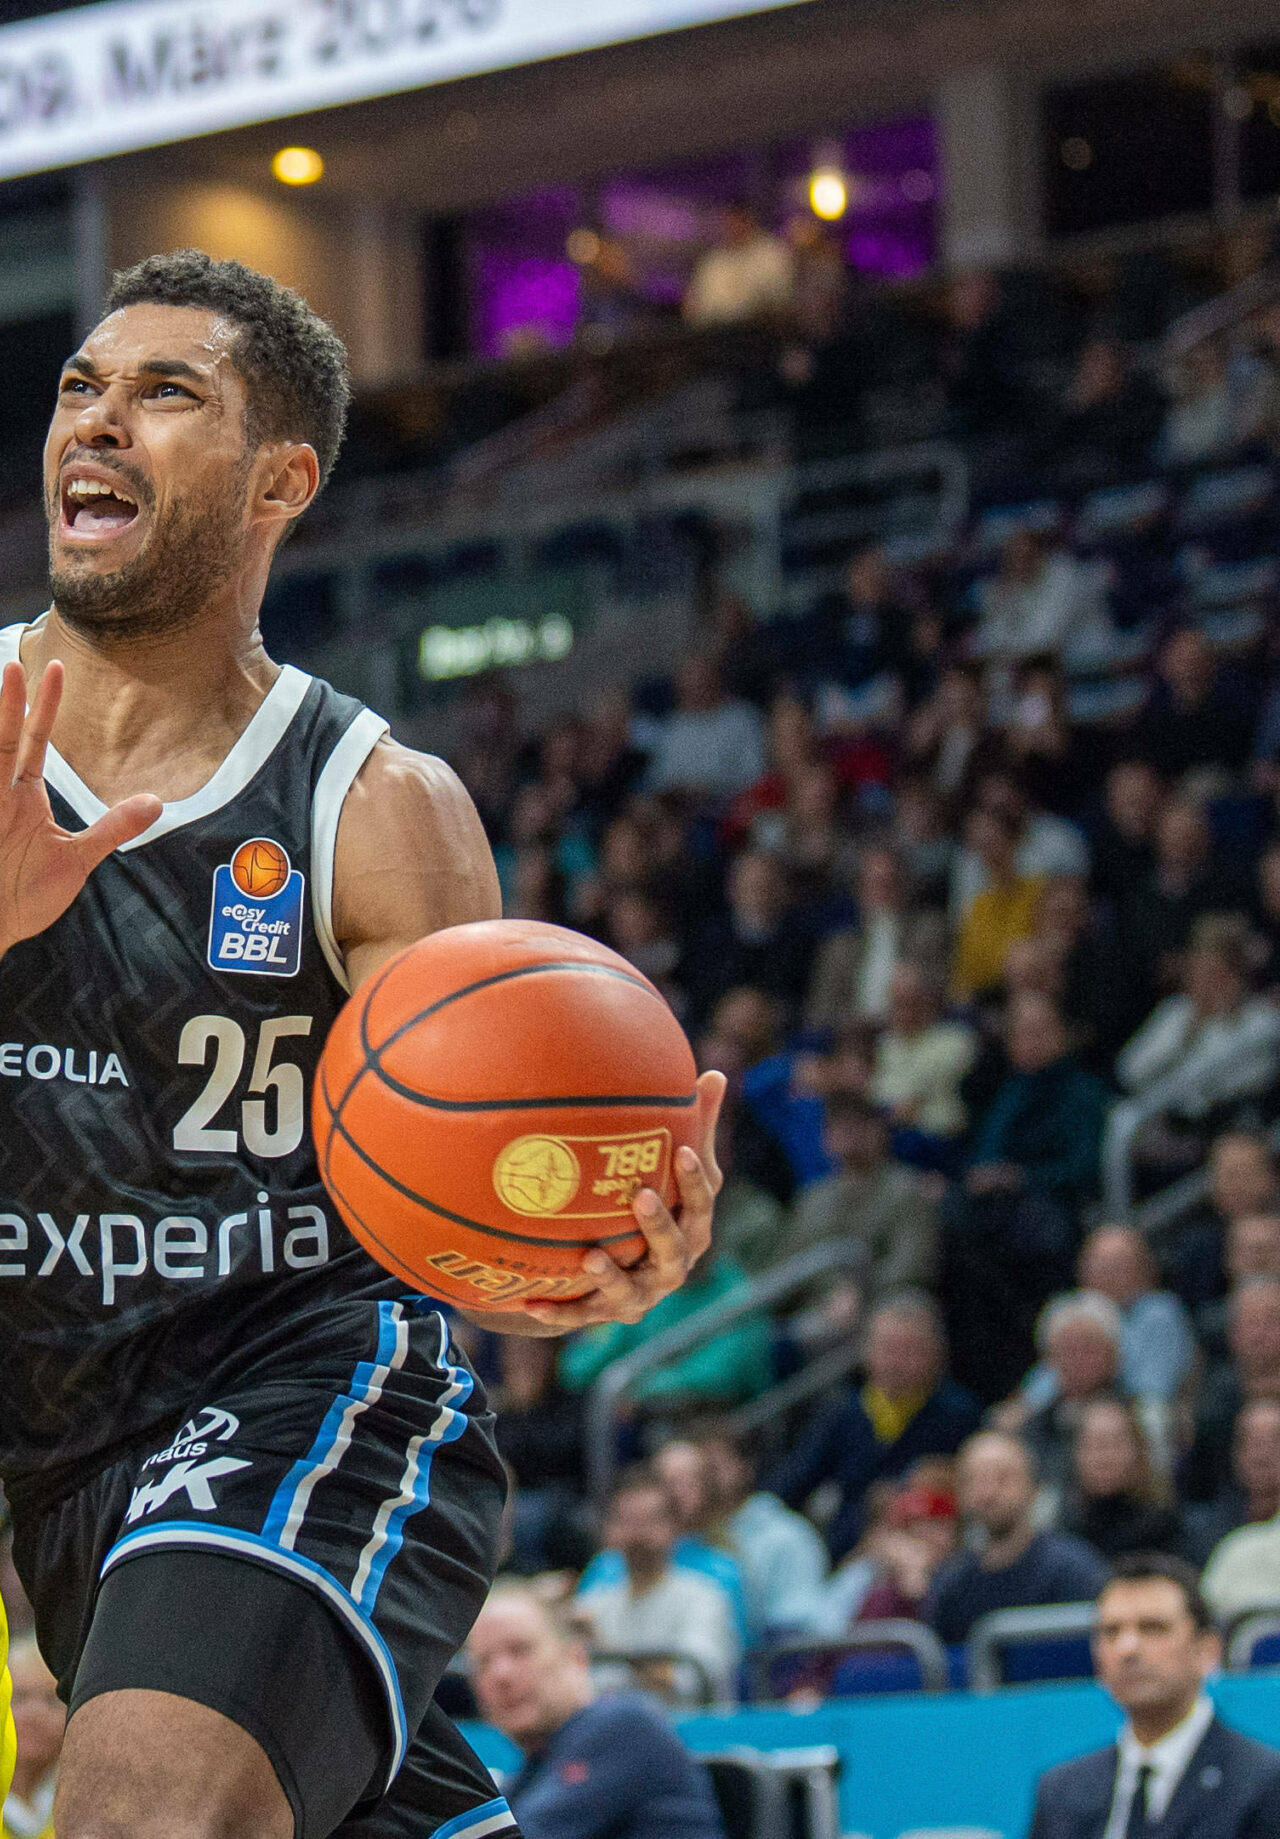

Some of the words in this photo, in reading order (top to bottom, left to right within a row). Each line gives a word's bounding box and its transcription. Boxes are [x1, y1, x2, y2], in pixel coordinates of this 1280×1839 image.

[241, 918, 291, 936] Credit
[218, 932, 287, 964] BBL
[173, 1015, 313, 1158] 25
[598, 1139, 662, 1177] BBL
